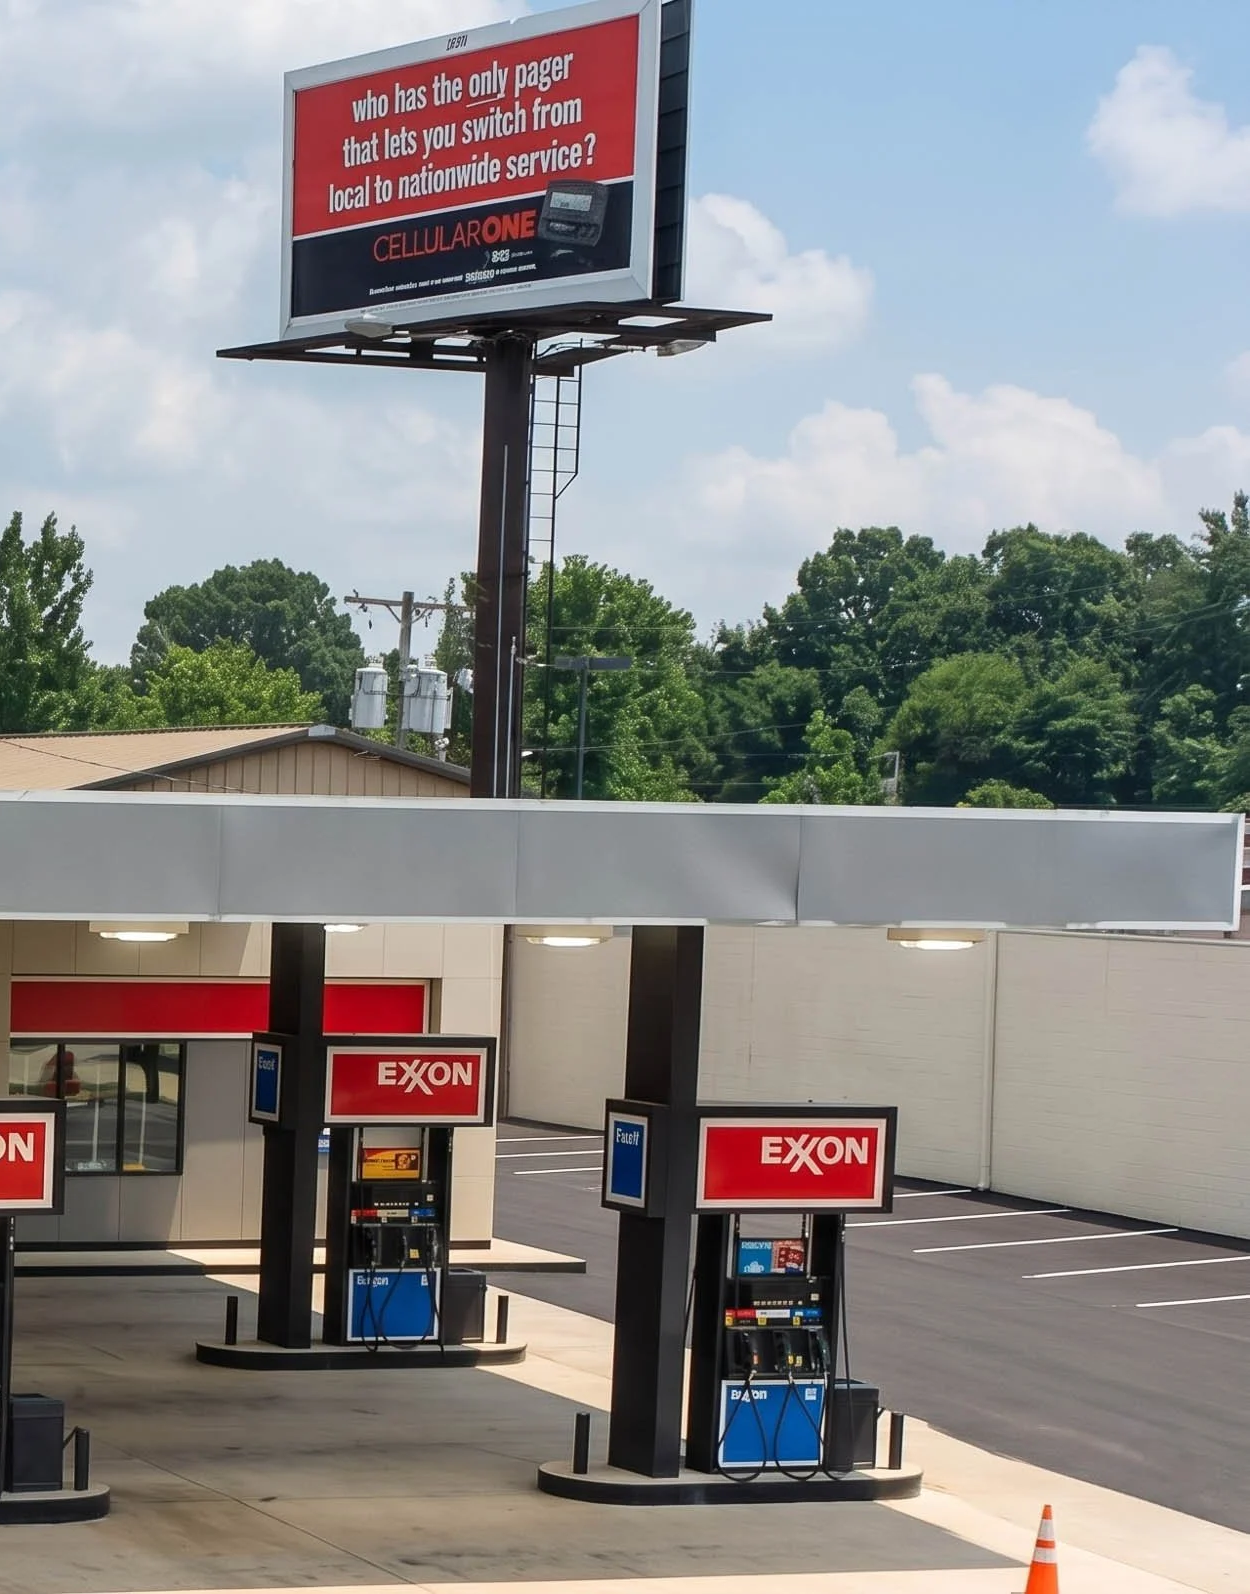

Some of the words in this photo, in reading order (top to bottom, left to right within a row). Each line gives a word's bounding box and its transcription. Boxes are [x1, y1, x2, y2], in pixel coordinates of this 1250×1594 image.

[353, 90, 387, 123] who
[395, 83, 427, 114] has
[433, 73, 462, 106] the
[468, 60, 509, 100] only
[515, 53, 573, 98] pager
[343, 132, 379, 168] that
[384, 125, 417, 159] lets
[422, 122, 456, 160] you
[462, 101, 526, 145] switch
[532, 97, 582, 131] from
[329, 175, 370, 213] local
[374, 174, 393, 204] to
[398, 152, 500, 199] nationwide
[506, 132, 596, 180] service?
[378, 1059, 473, 1096] EXXON
[760, 1133, 869, 1176] EXXON
